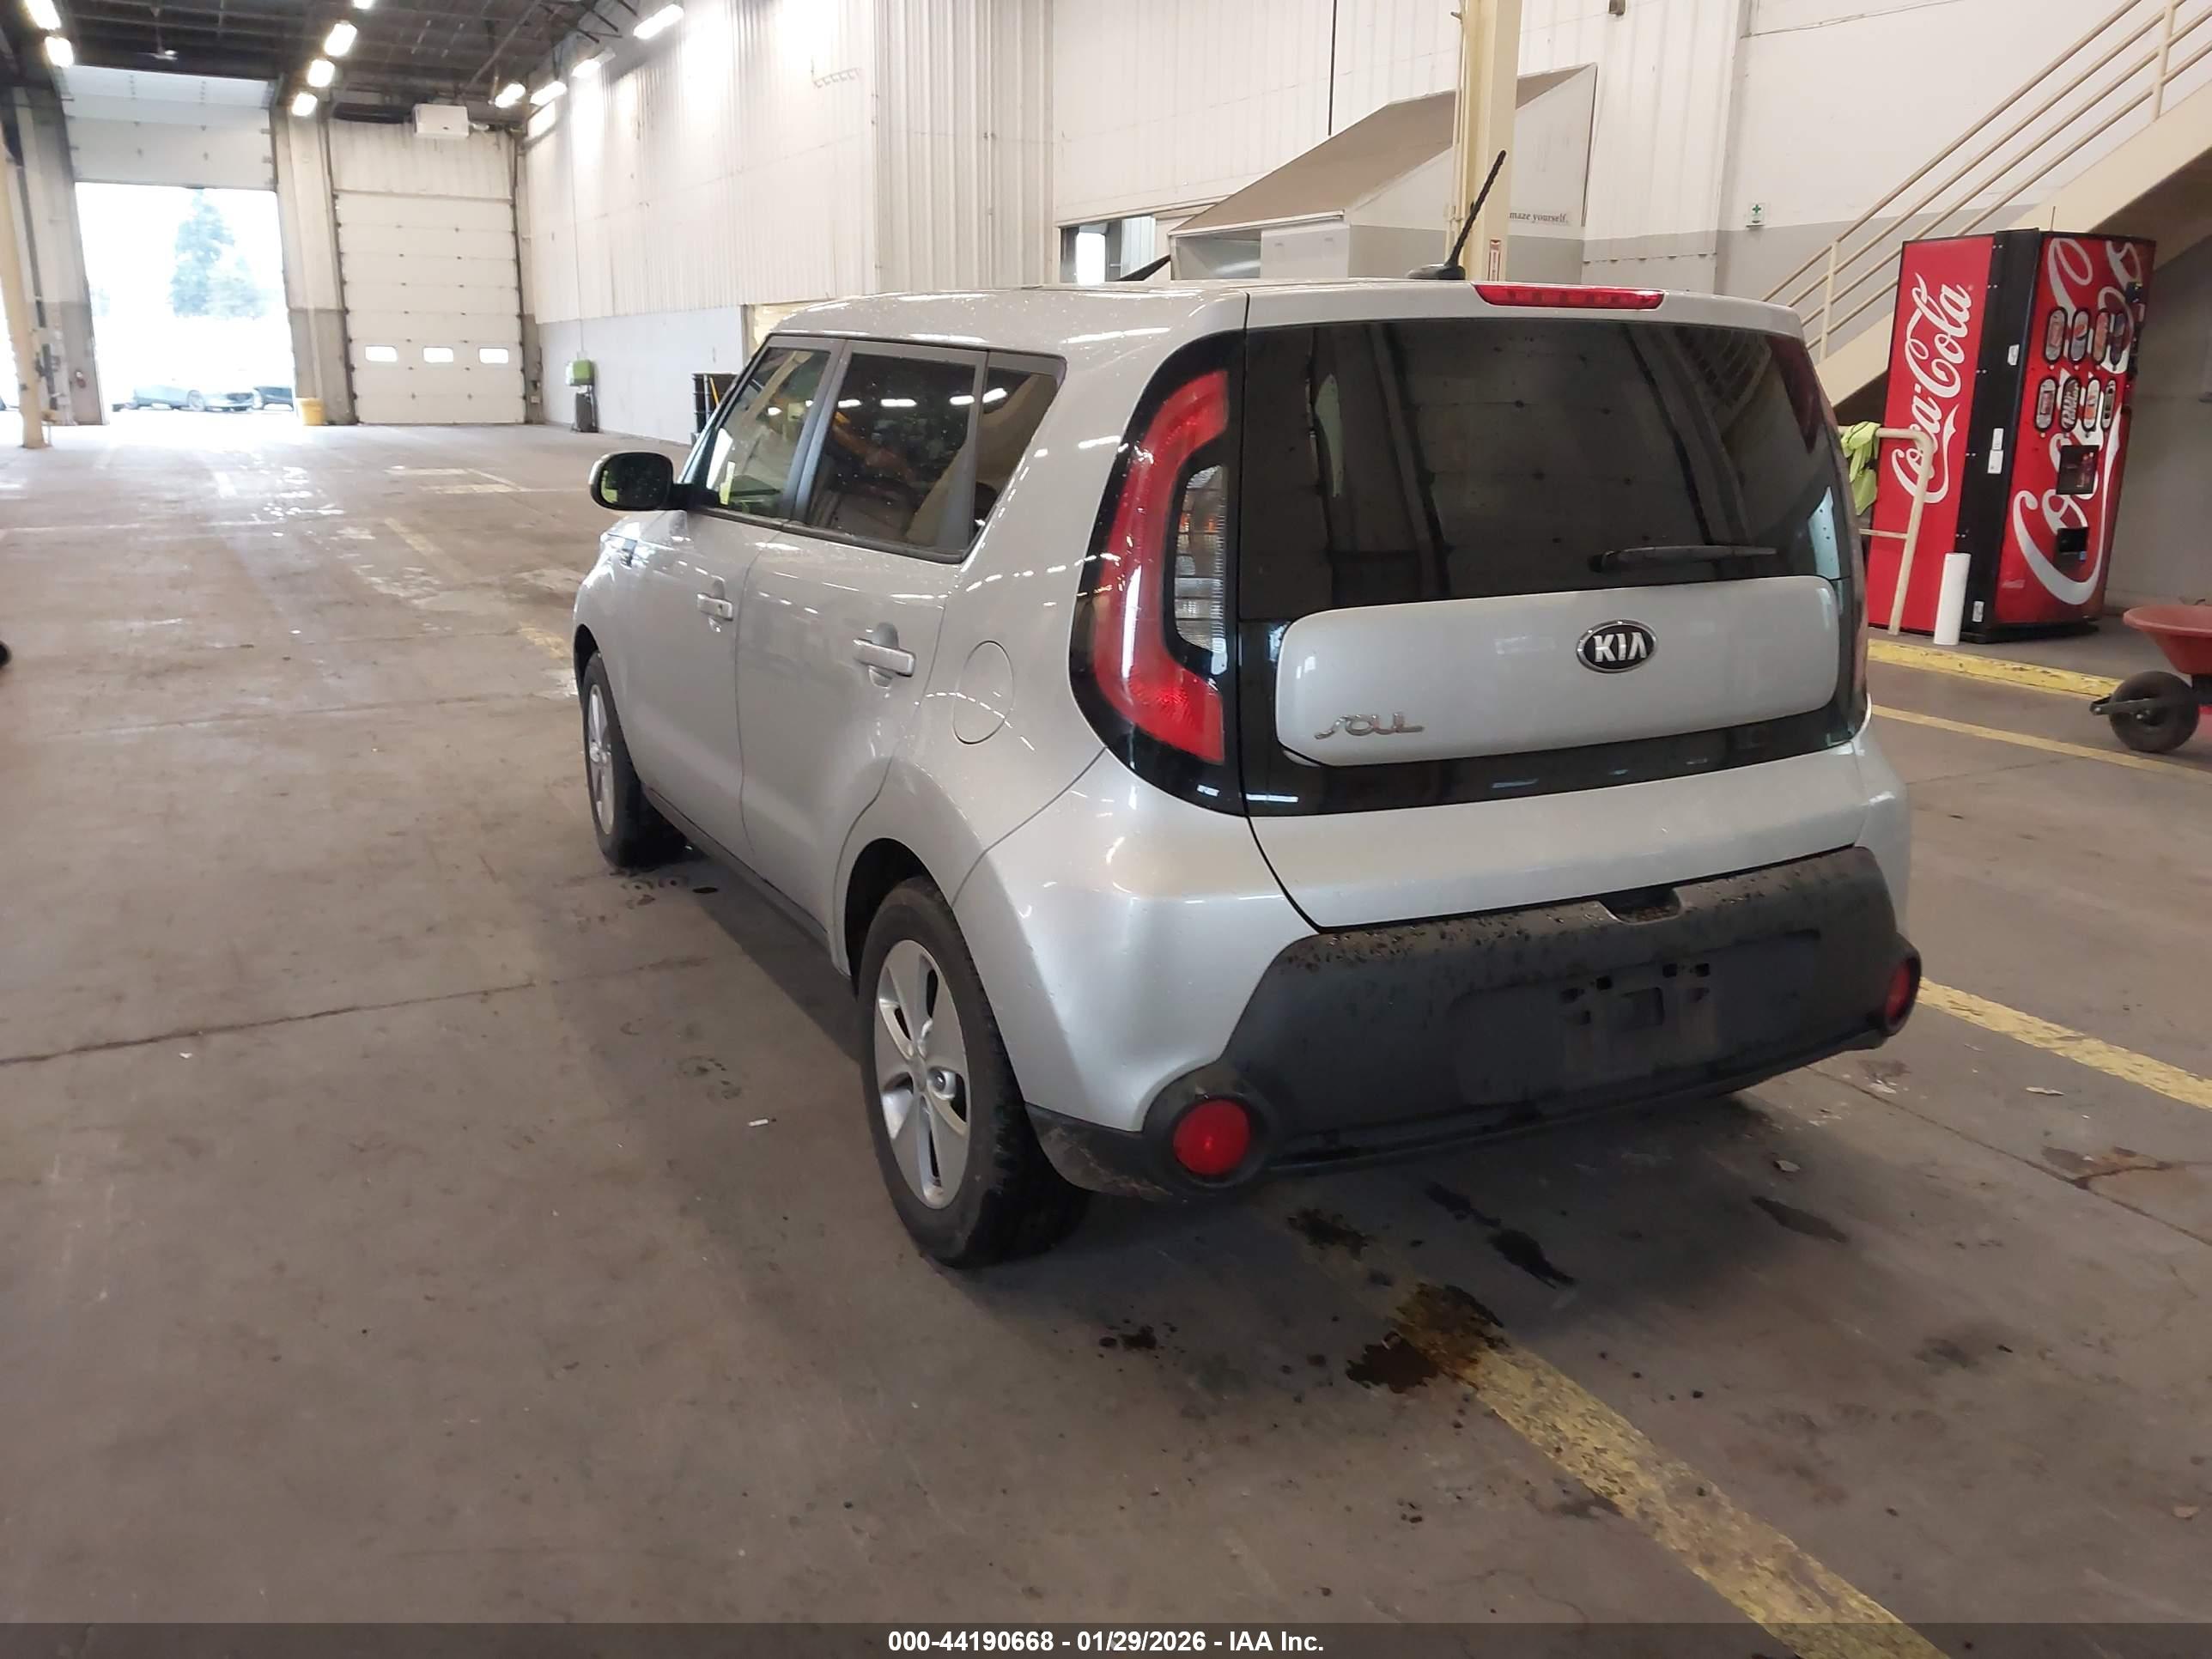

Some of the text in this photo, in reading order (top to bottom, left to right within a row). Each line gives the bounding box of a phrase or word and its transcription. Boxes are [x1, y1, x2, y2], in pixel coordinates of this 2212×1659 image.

[1509, 212, 1531, 221] maze
[1593, 632, 1648, 662] KIA
[1314, 711, 1425, 739] SOUL
